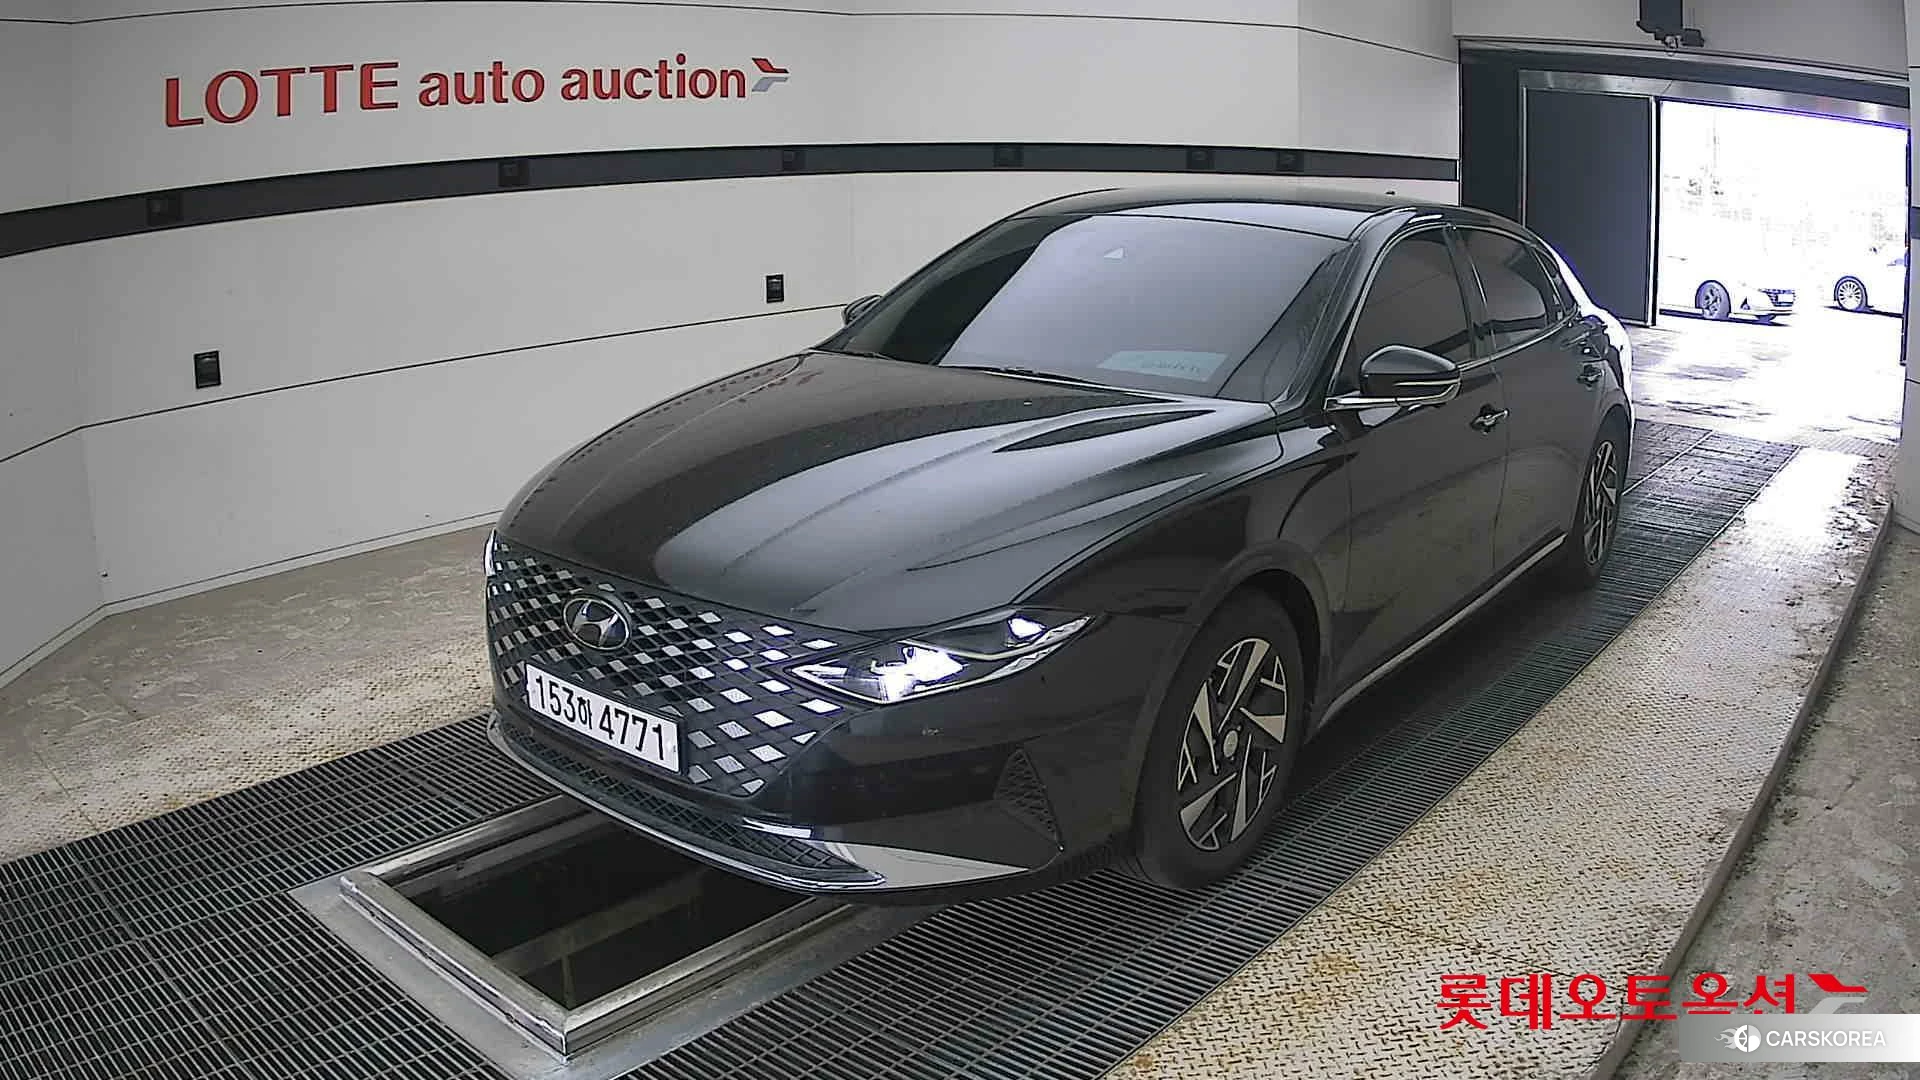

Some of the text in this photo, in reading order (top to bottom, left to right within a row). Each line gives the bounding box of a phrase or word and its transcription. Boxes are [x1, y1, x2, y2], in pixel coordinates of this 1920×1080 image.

[165, 53, 747, 127] LOTTE auto auction
[535, 675, 664, 761] 153하 4771
